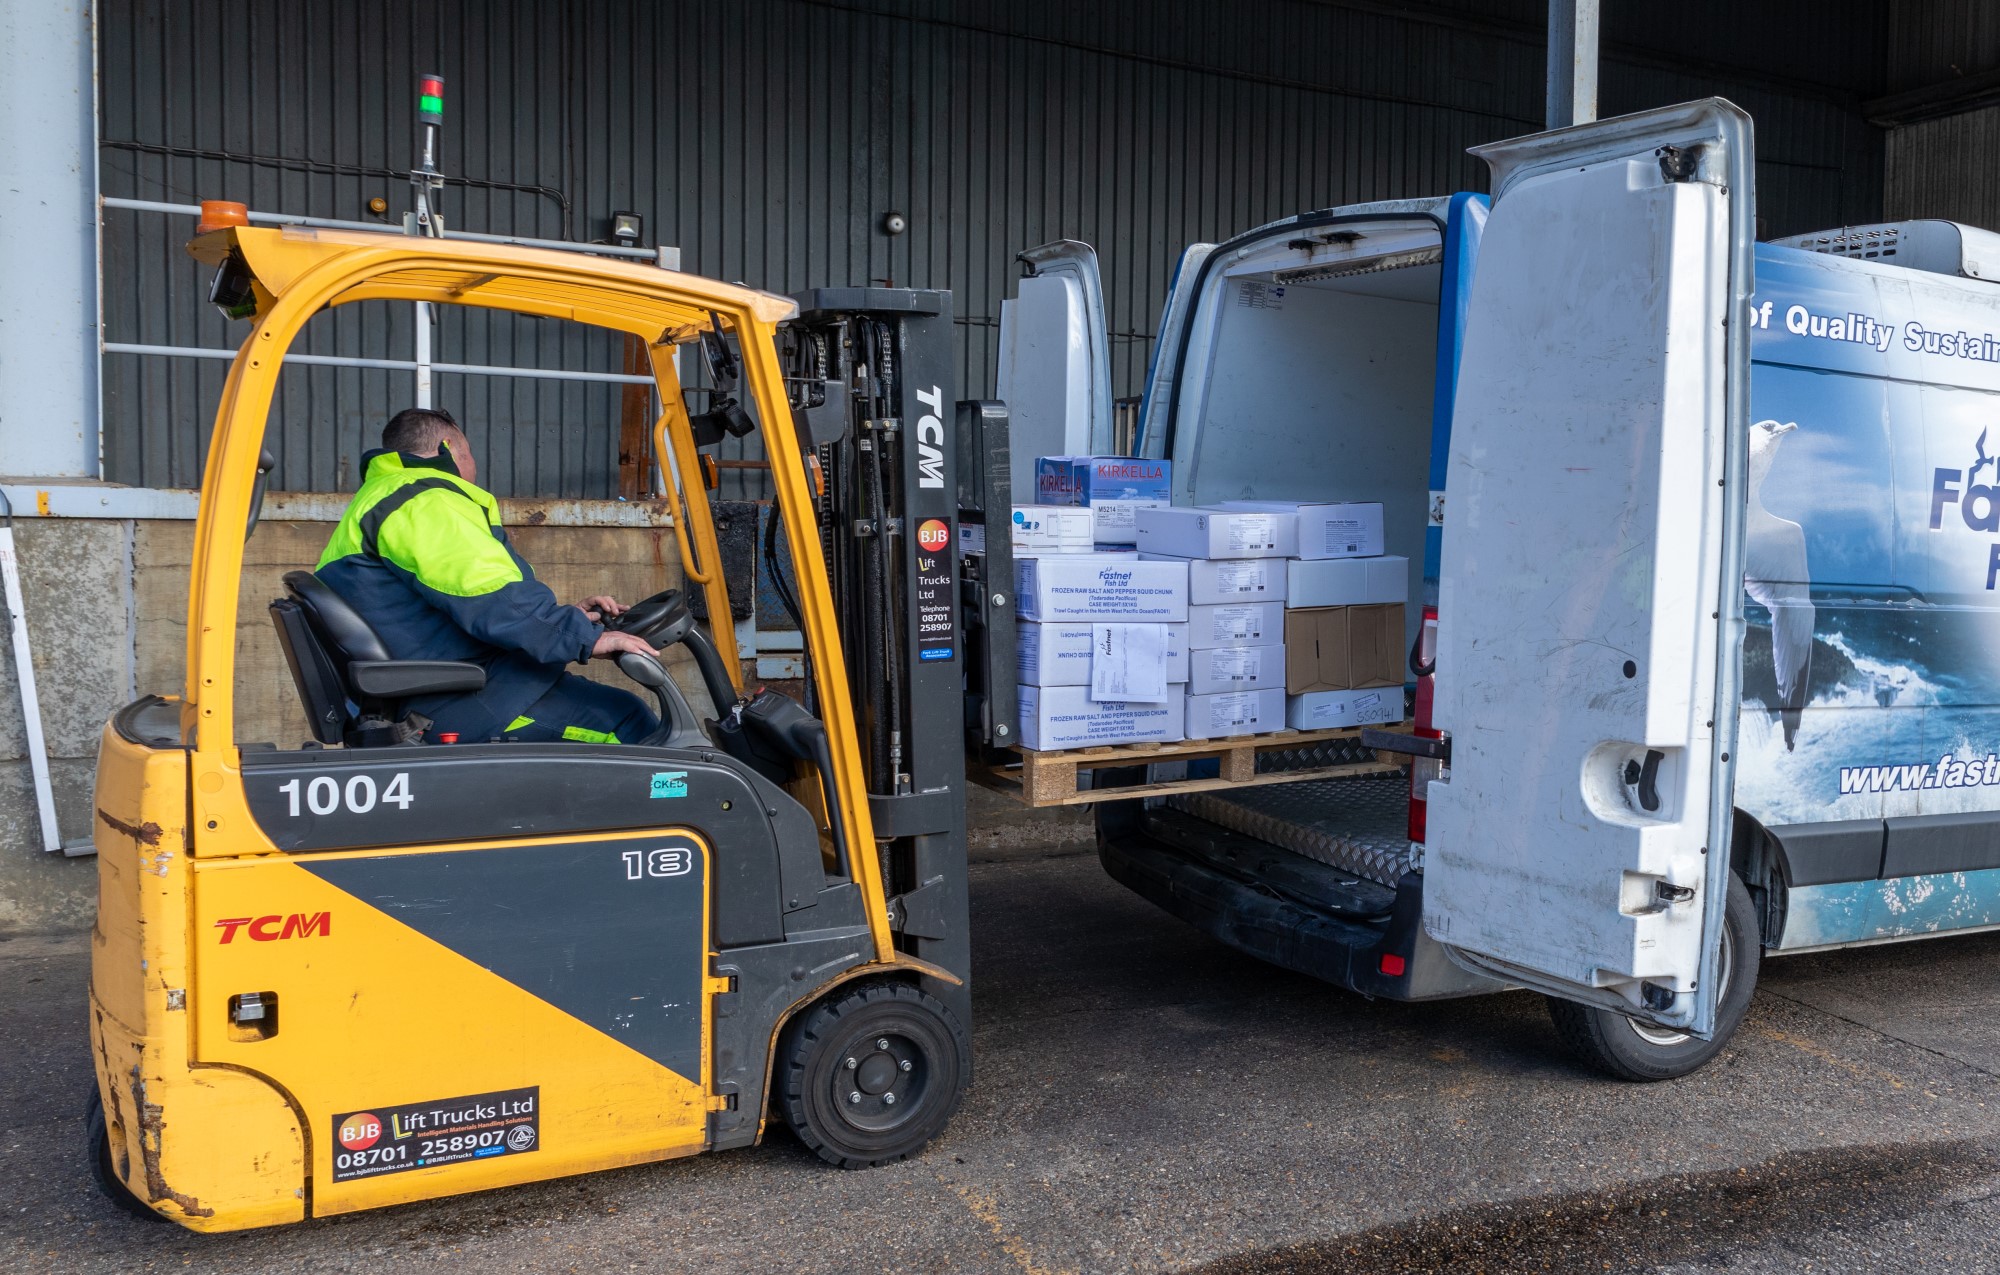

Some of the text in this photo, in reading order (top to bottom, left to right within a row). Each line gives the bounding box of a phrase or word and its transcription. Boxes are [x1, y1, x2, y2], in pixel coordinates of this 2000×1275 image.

[1786, 304, 1894, 352] Quality
[916, 385, 944, 488] TCM
[1097, 465, 1163, 479] KIRKELLA
[1040, 474, 1082, 493] KIRKELLA
[920, 530, 947, 542] BJB
[918, 558, 935, 571] Lift
[918, 576, 950, 585] Trucks
[1098, 571, 1132, 580] Fastnet
[919, 590, 934, 599] Ltd
[920, 623, 952, 632] 258907
[922, 614, 948, 622] 08701
[278, 773, 414, 817] 1004
[622, 848, 692, 880] 18
[214, 912, 330, 944] TCM
[343, 1097, 533, 1142] BJB Lift Trucks Ltd
[418, 1116, 532, 1138] Intelligent Materials Handling Solutions
[337, 1145, 406, 1169] 08701
[421, 1130, 505, 1156] 258907
[338, 1152, 472, 1178] www.bjblifttrucks.co.uk @BJBLiftTrucks
